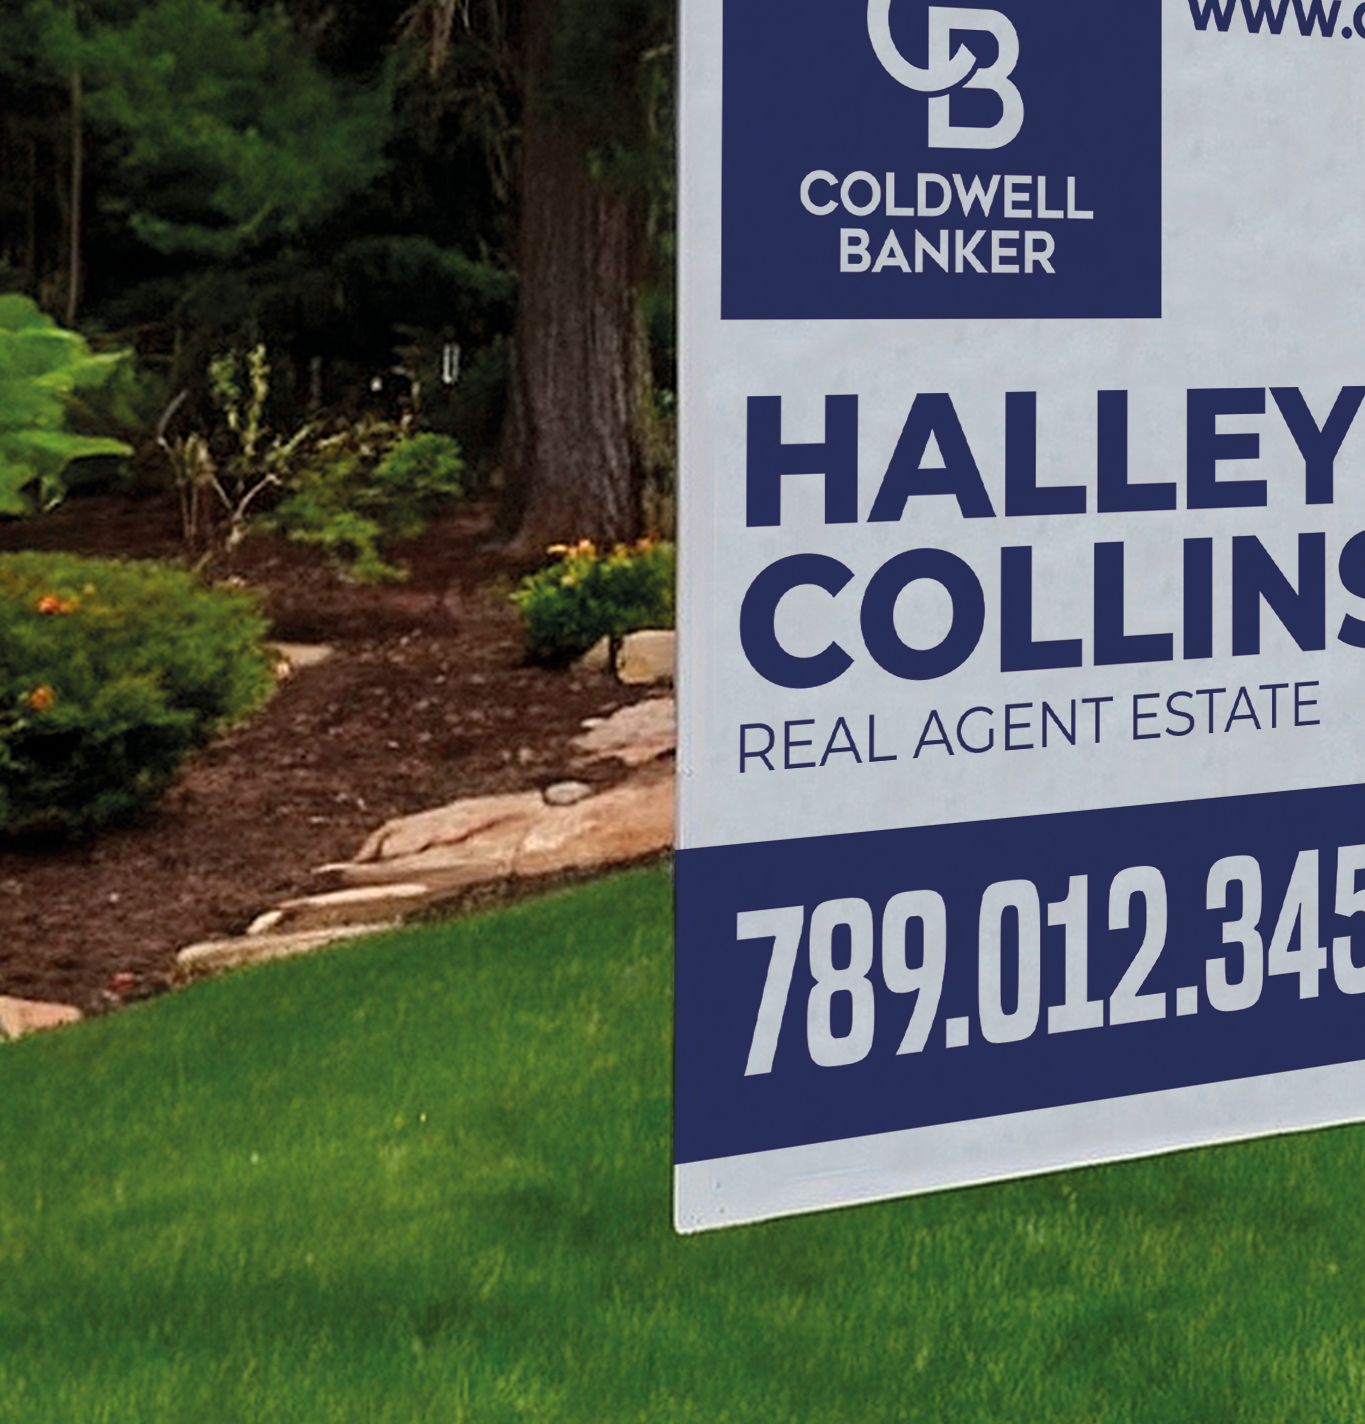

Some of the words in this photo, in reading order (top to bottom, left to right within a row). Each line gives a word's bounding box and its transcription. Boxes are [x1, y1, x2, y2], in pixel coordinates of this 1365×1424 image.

[799, 168, 1095, 221] COLDWELL
[838, 226, 1057, 275] BANKER
[738, 713, 898, 775] REAL
[911, 696, 1115, 760] AGENT
[1131, 679, 1322, 742] ESTATE
